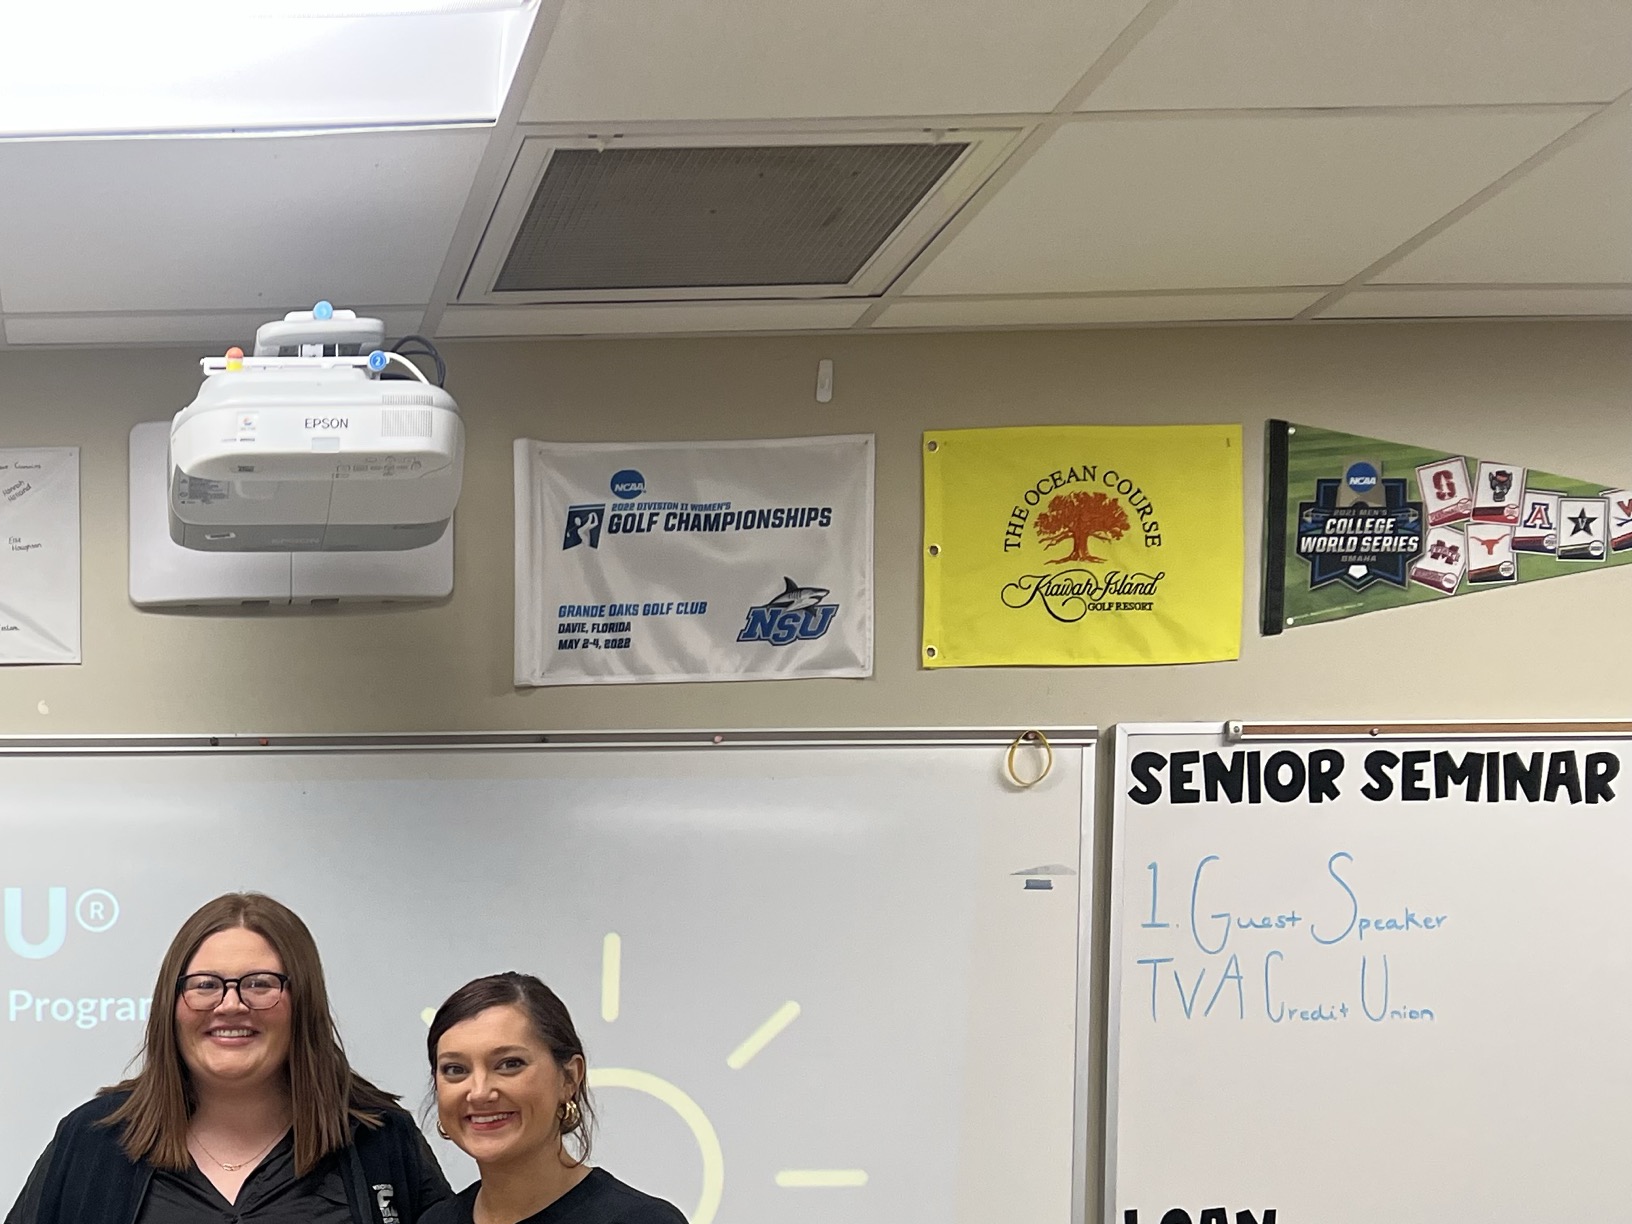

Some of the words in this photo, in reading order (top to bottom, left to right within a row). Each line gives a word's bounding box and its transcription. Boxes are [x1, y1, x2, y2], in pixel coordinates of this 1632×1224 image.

[304, 418, 349, 429] EPSON
[614, 482, 645, 492] NCAA
[1348, 476, 1377, 485] NCAA
[611, 502, 635, 512] 2022
[636, 502, 679, 511] DIVISION
[680, 502, 689, 511] II
[690, 501, 731, 512] WOMEN'S
[1004, 505, 1030, 553] THE
[1024, 465, 1098, 506] OCEAN
[1102, 470, 1162, 548] COURSE
[607, 511, 660, 534] GOLF
[663, 507, 833, 533] CHAMPIONSHIPS
[1523, 502, 1553, 530] A
[1325, 518, 1396, 535] COLLEGE
[1300, 536, 1358, 553] WORLD
[1360, 535, 1419, 553] SERIES
[1000, 568, 1103, 623] Kiawah
[1092, 570, 1166, 602] Island
[558, 604, 605, 618] GRANDE
[608, 603, 639, 617] OAKS
[642, 602, 673, 616] GOLF
[675, 601, 708, 615] CLUB
[1087, 602, 1114, 612] GOLF
[1115, 602, 1154, 612] RESORT
[558, 622, 589, 635] DAVIE,
[591, 621, 632, 634] FLORIDA
[736, 603, 840, 647] NSU
[558, 638, 580, 650] MAY
[603, 637, 632, 649] 2022
[1127, 749, 1345, 805] SENIOR
[1360, 749, 1621, 805] SEMINAR
[1141, 861, 1180, 929] 1.
[1191, 854, 1302, 955] Guest
[1311, 851, 1448, 945] Speaker
[1136, 953, 1244, 1023] TVA
[1264, 950, 1349, 1023] Credit
[1361, 954, 1437, 1023] Union
